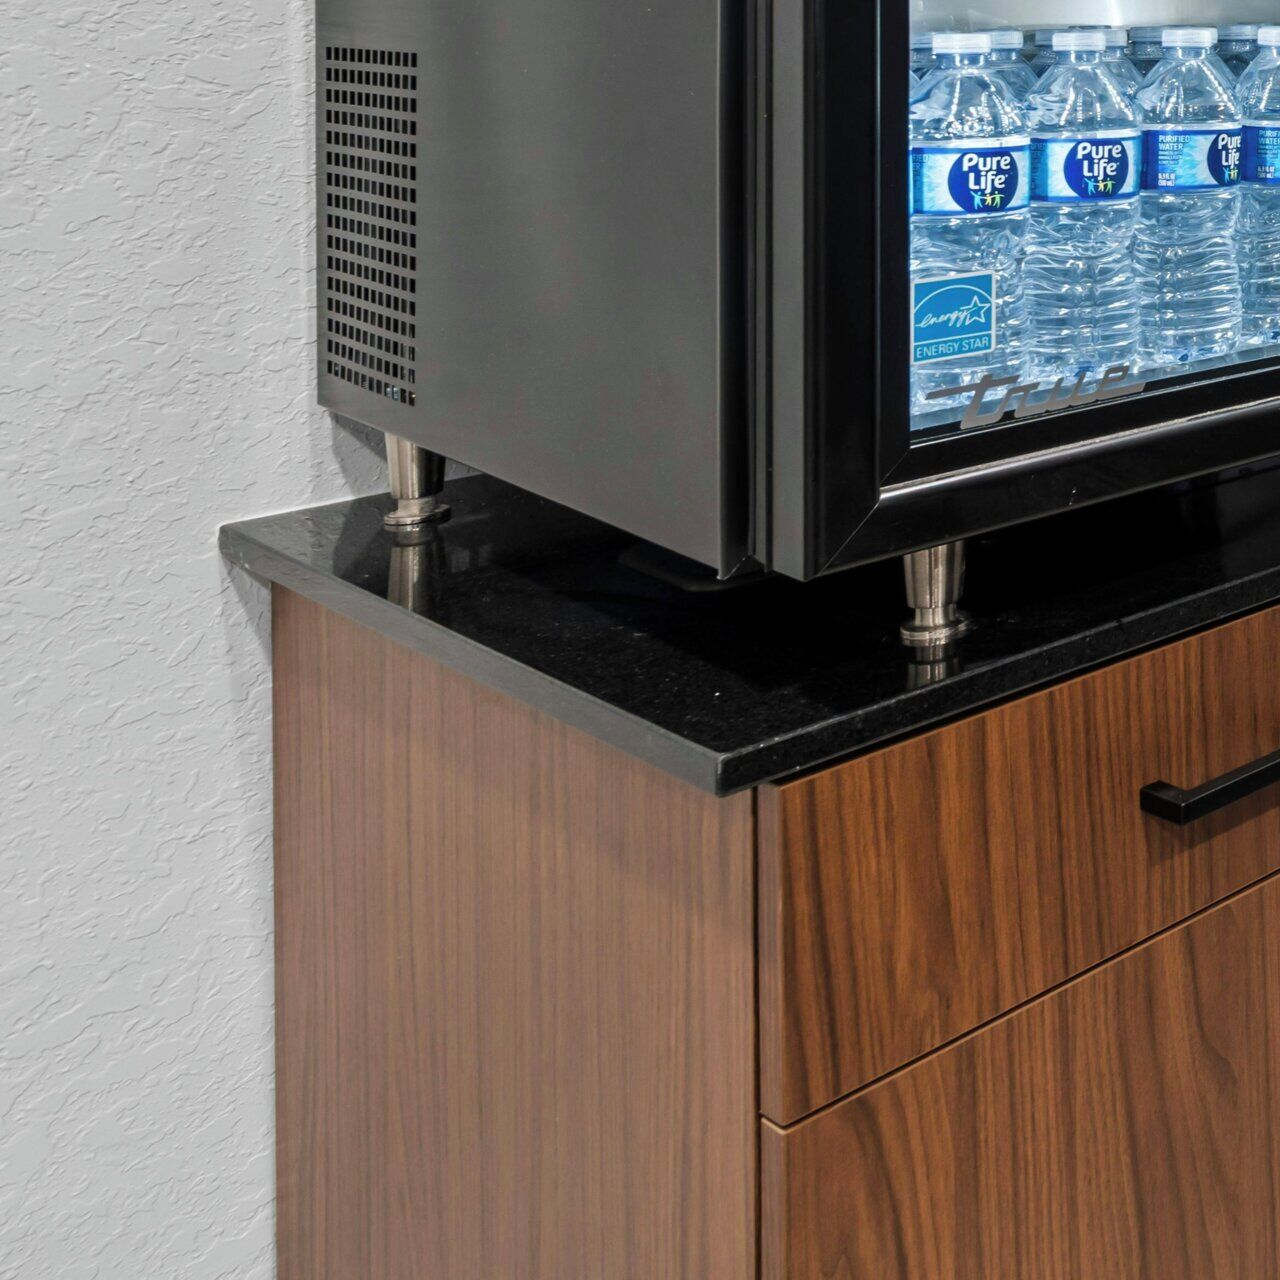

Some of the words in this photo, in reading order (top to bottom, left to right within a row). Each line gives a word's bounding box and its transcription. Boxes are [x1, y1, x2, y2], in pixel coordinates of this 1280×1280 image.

[1158, 135, 1191, 143] PURIFIED
[1158, 142, 1183, 151] WATER
[1076, 142, 1122, 160] Pure
[1221, 149, 1240, 169] Life
[962, 153, 1011, 171] Pure
[1082, 160, 1118, 181] Life
[968, 171, 1006, 194] Life
[916, 342, 960, 359] ENERGY
[962, 336, 989, 351] STAR
[925, 363, 1148, 430] true
